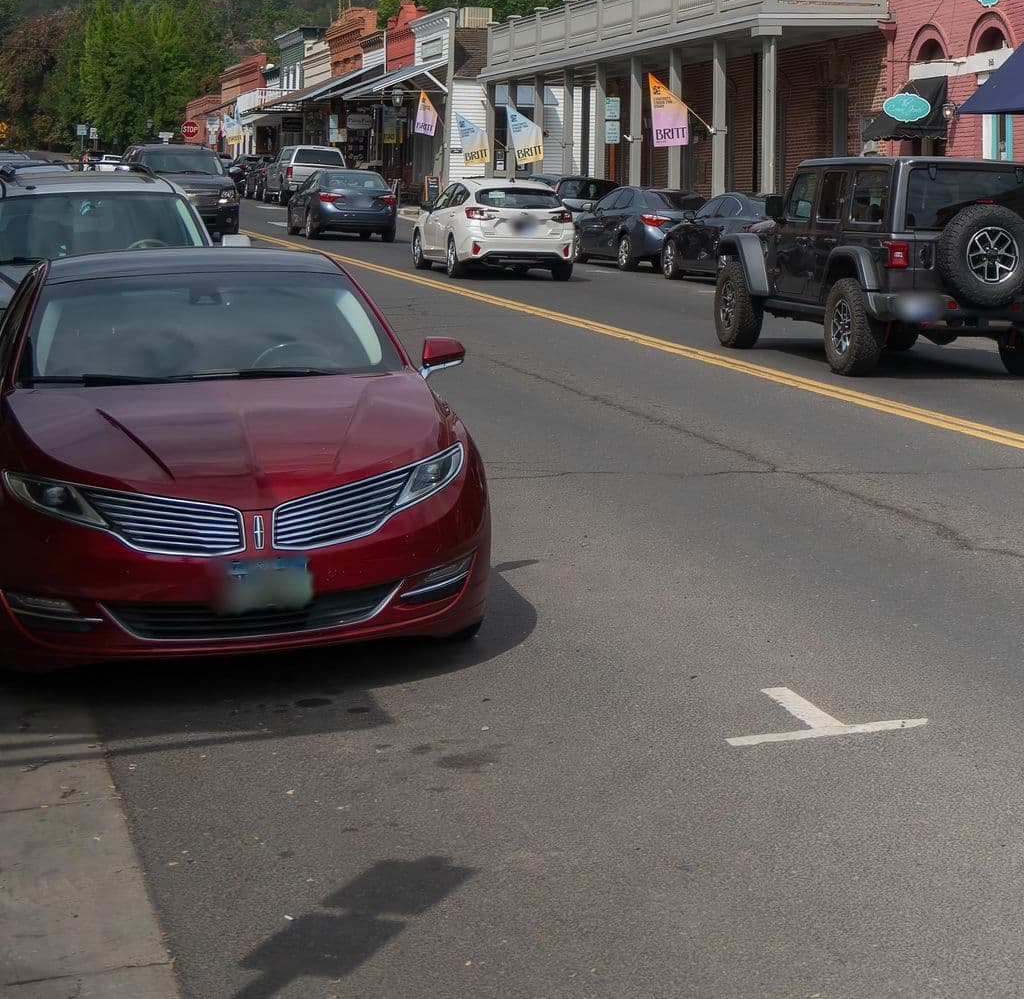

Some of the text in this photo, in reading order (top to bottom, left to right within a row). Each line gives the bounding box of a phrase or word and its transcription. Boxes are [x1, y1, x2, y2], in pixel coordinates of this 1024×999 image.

[416, 122, 434, 132] BRITT
[655, 127, 687, 141] BRITT
[465, 149, 488, 162] BRITT
[516, 145, 543, 159] BRITT
